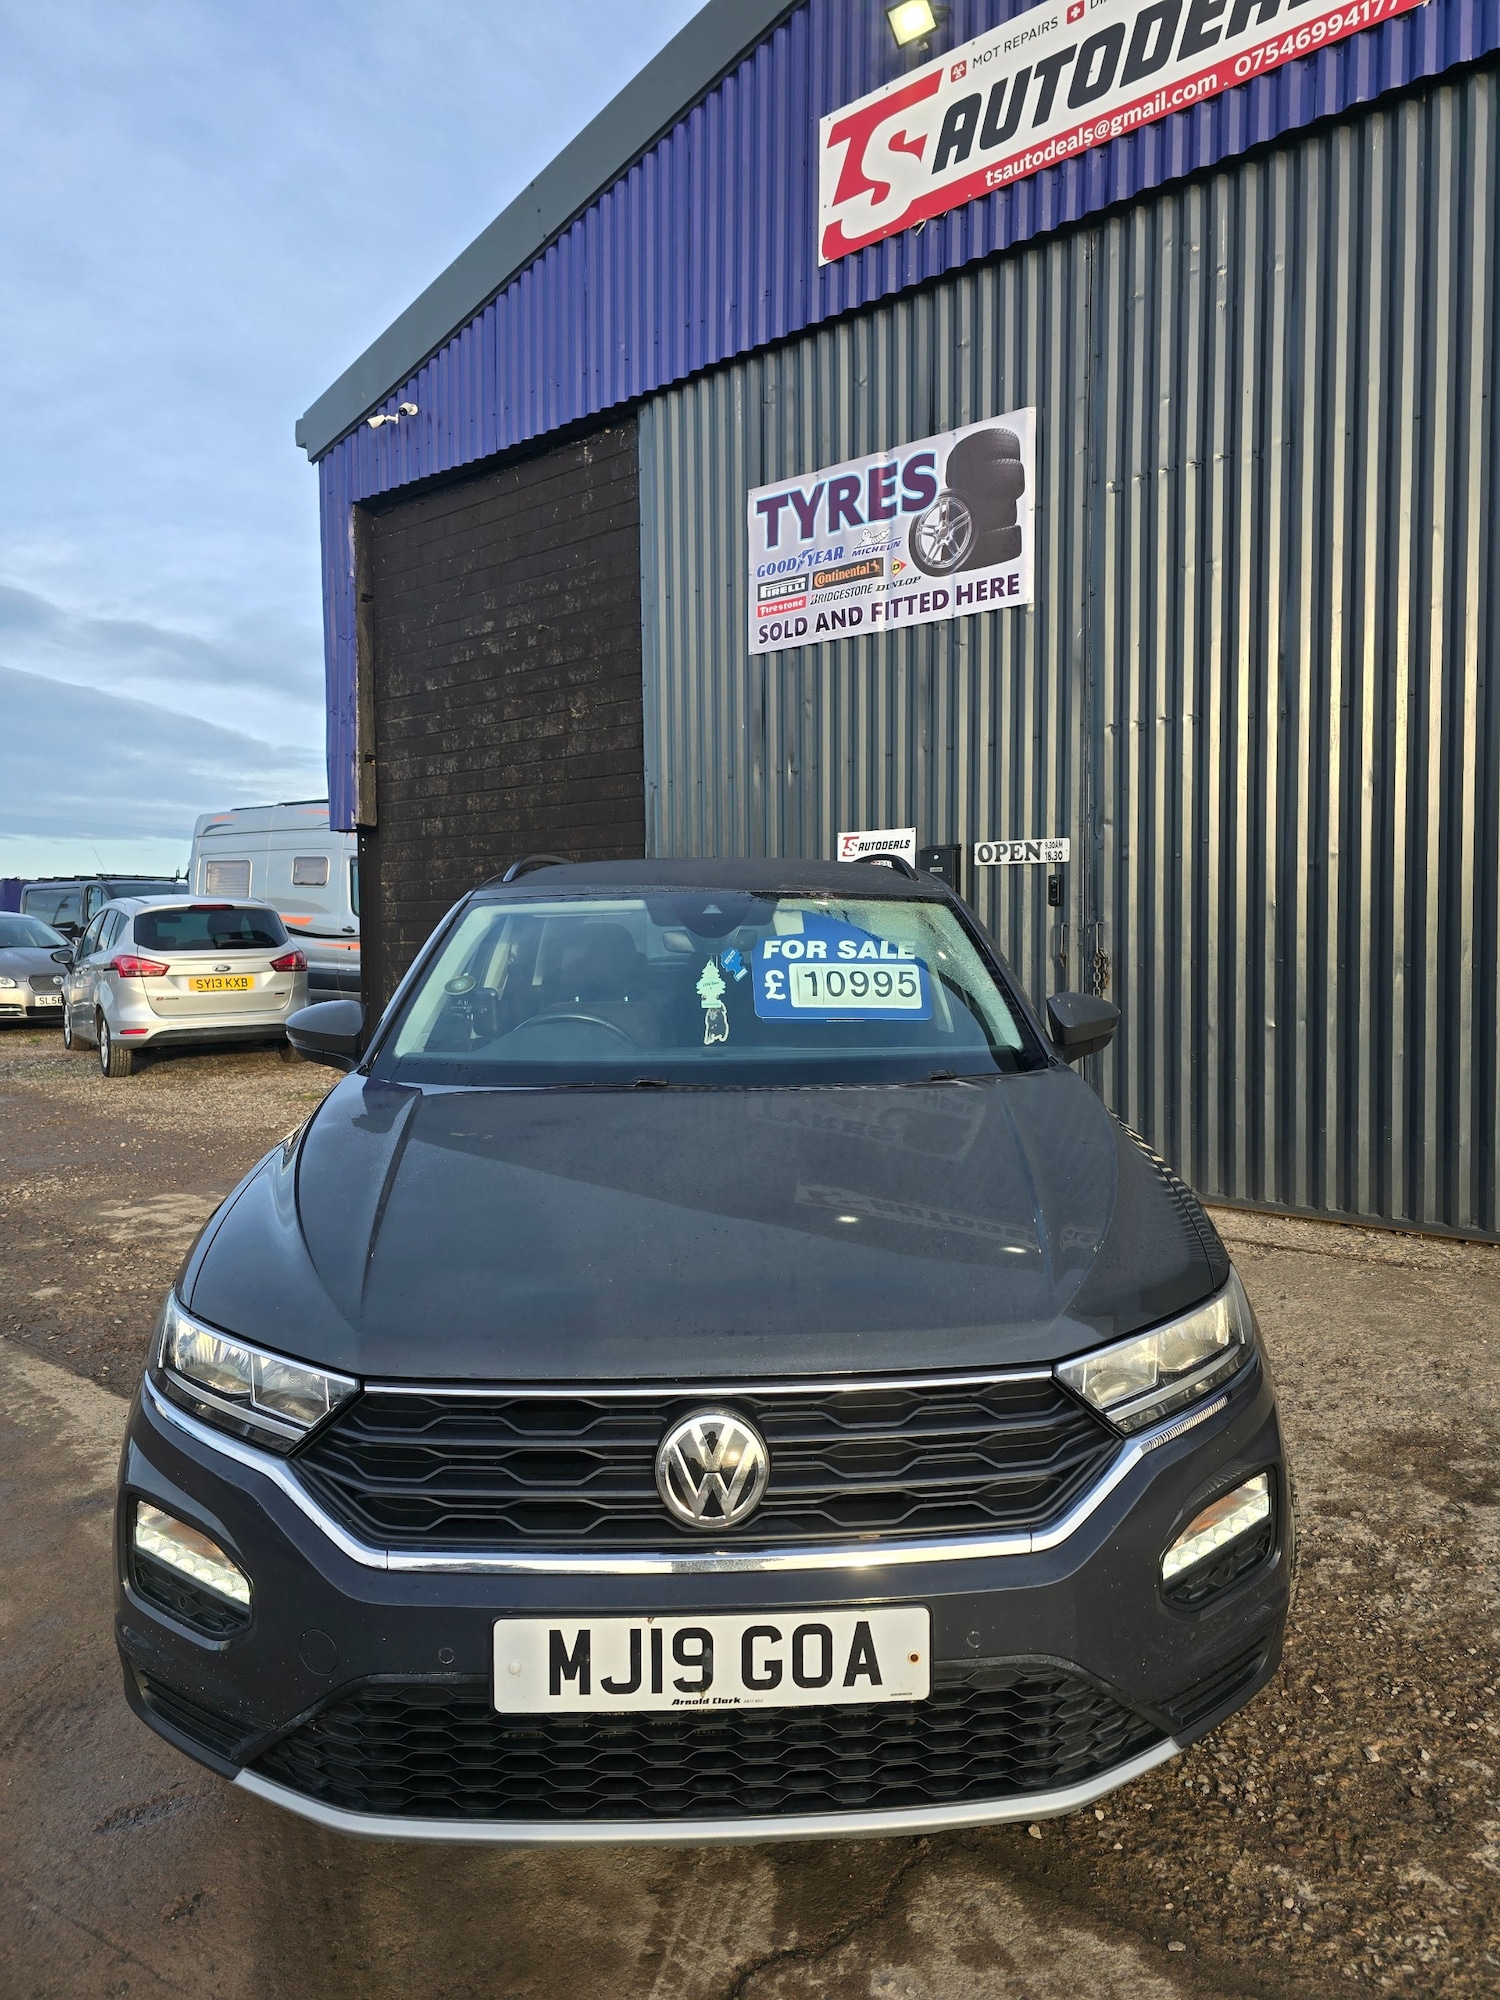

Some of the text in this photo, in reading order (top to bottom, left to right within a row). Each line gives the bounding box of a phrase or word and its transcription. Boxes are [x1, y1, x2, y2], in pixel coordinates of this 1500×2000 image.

[972, 16, 1058, 69] MOT REPAIRS
[985, 73, 1218, 187] tsautodeals@gmail.com
[756, 452, 937, 549] TYRES
[851, 540, 901, 557] MICHELIN
[756, 546, 845, 577] GOODYEAR
[813, 565, 870, 588] Continental
[875, 576, 921, 591] DUNLOP
[760, 577, 805, 598] PIRELLI
[810, 584, 873, 605] BRIDGESTONE
[758, 573, 1020, 644] SOLD AND FITTED HERE
[760, 599, 804, 616] Firestone
[858, 840, 911, 851] AUTODEALS
[977, 841, 1043, 863] OPEN
[1045, 850, 1063, 861] 18.30
[763, 939, 916, 959] FOR SALE
[196, 977, 248, 989] SY13 KXB
[765, 969, 787, 1000] £
[804, 970, 917, 998] 10995
[549, 1621, 883, 1695] MJ19 GOA
[671, 1698, 709, 1706] Arnold
